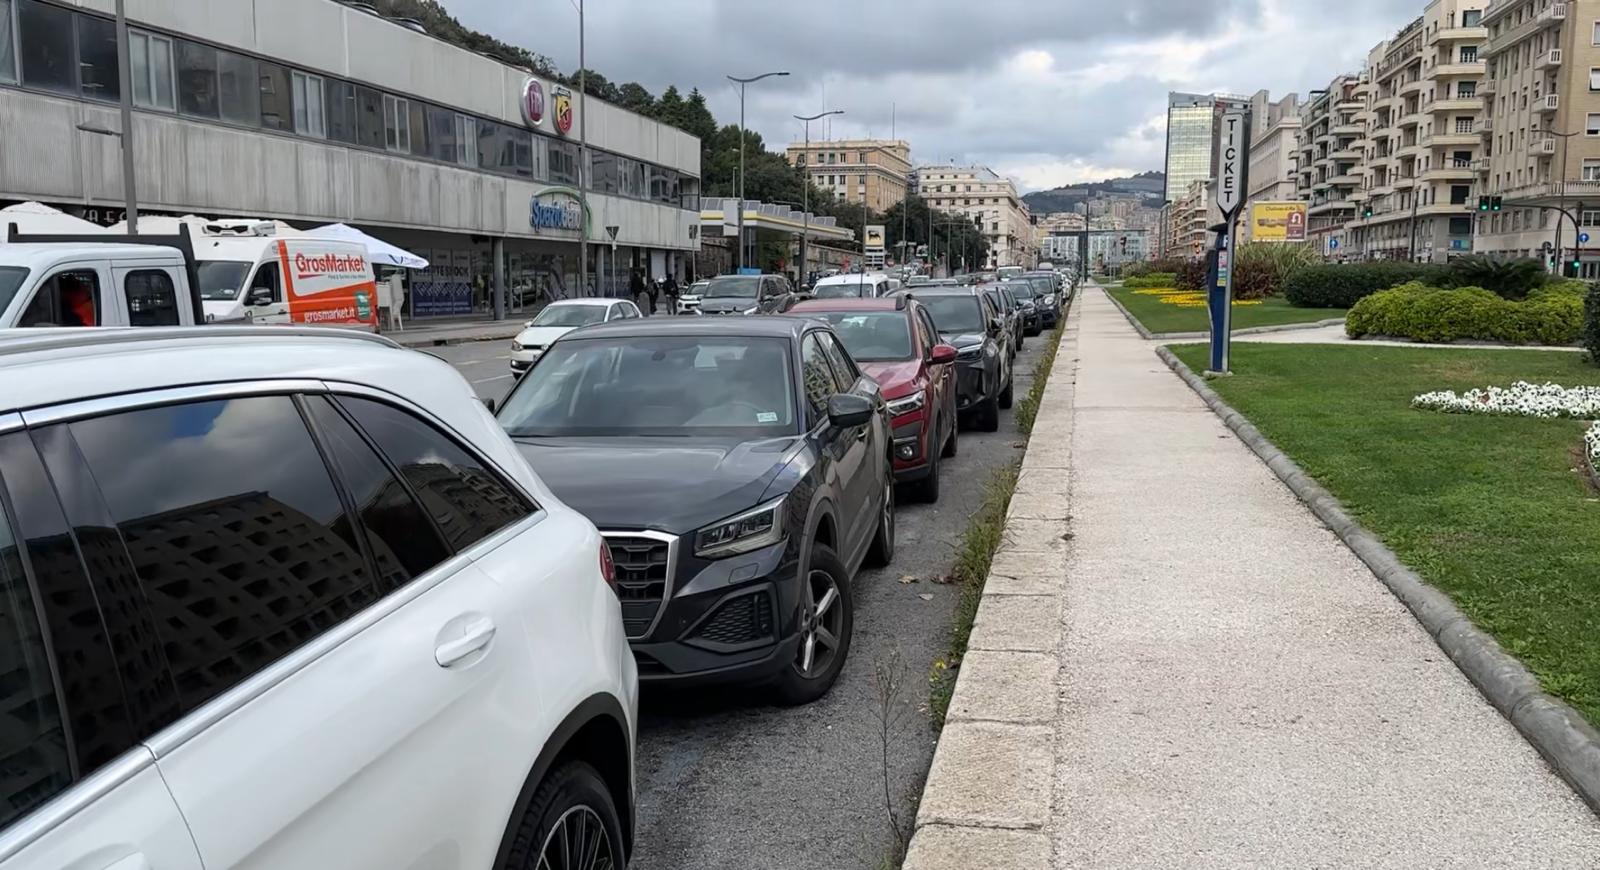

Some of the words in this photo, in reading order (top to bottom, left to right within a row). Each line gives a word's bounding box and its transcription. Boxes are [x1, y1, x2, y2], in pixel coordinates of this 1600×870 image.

[1224, 119, 1237, 203] TICKET
[296, 253, 366, 273] GrosMarket
[304, 307, 356, 324] grosmarket.it
